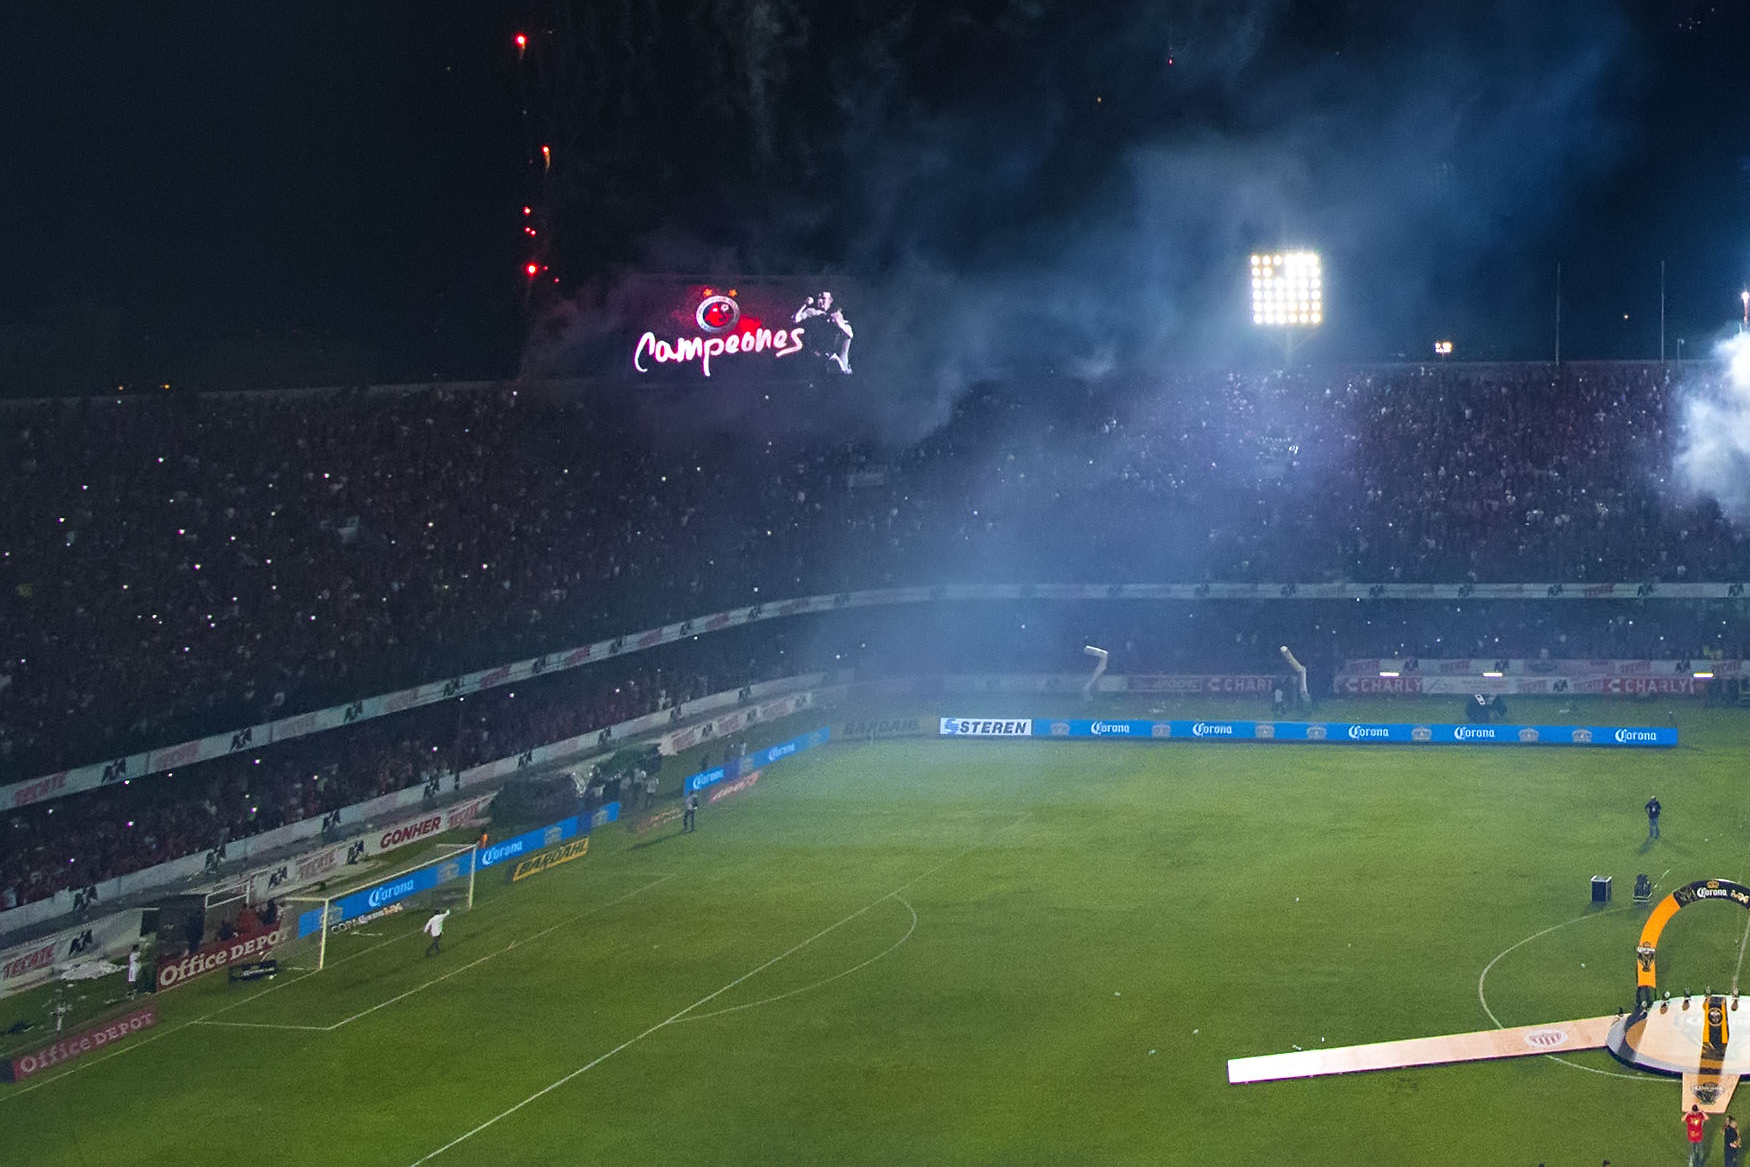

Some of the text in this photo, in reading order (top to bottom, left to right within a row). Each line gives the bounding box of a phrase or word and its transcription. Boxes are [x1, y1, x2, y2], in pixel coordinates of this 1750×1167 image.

[634, 327, 805, 377] Campeones
[1625, 678, 1687, 693] CHARLY
[959, 720, 1028, 735] STEREN
[1090, 720, 1130, 735] Corona
[1192, 722, 1233, 737] Corona
[1348, 725, 1389, 739] Corona
[1453, 726, 1496, 740] Corona
[1614, 728, 1657, 743] Corona
[380, 816, 441, 850] GONHER
[481, 839, 523, 867] Corona
[368, 878, 414, 908] Corona
[1696, 887, 1728, 899] Corona
[2, 940, 57, 981] TECATE
[160, 926, 292, 987] Office DEPOT
[19, 1012, 153, 1074] Office DEPOT
